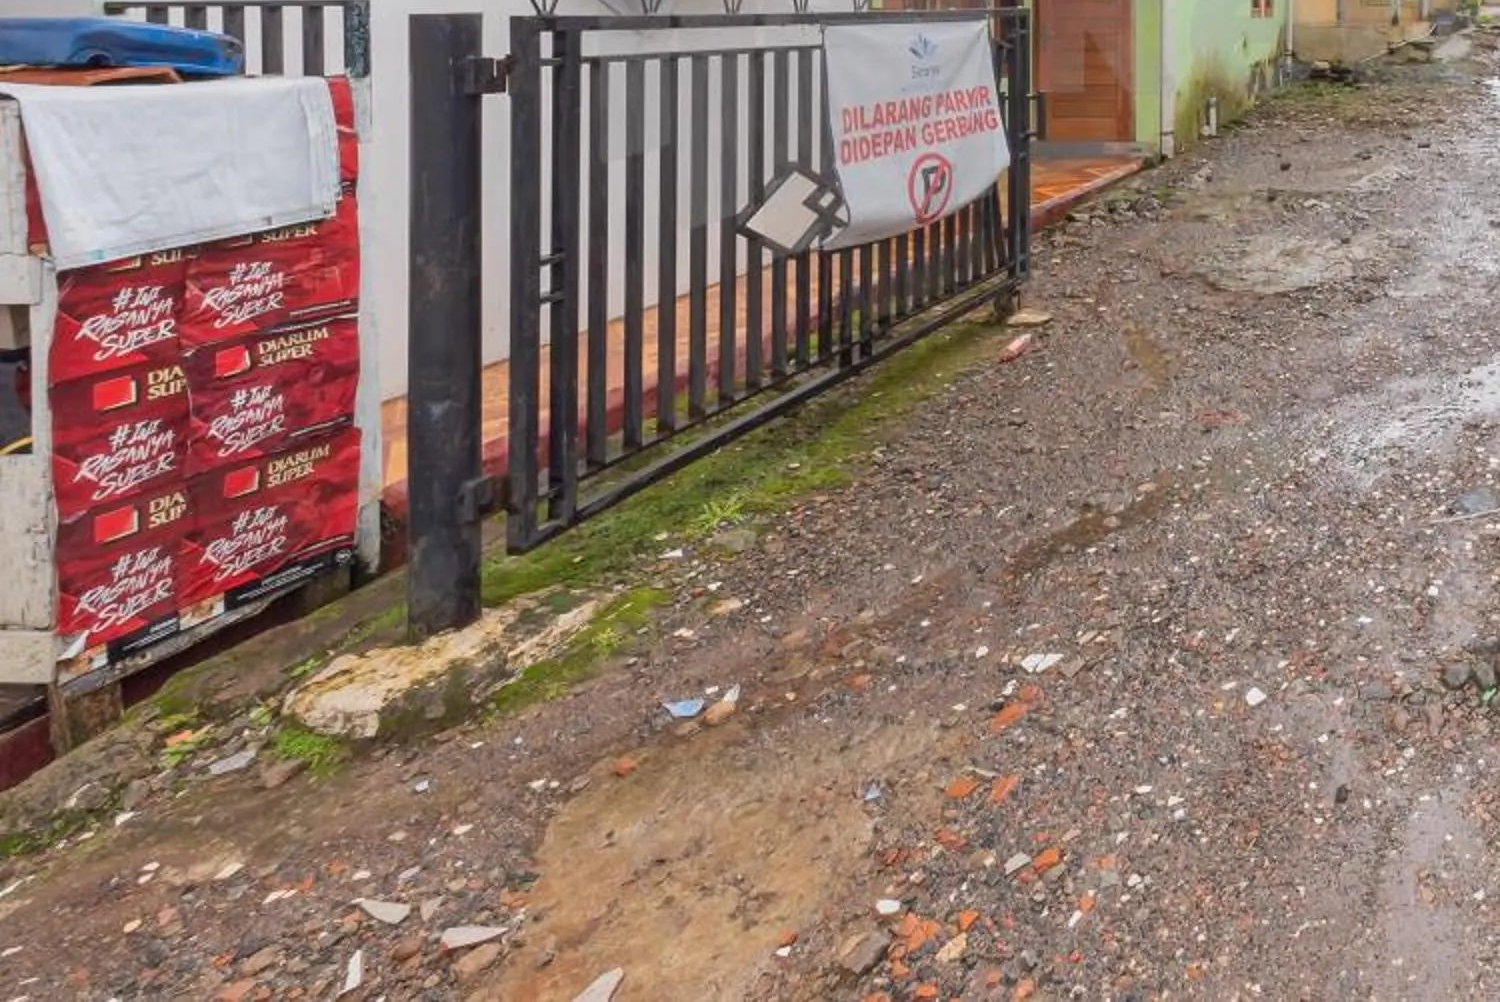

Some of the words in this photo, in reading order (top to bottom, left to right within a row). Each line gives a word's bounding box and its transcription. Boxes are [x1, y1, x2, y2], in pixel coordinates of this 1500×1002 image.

[841, 96, 932, 135] DILARANG
[840, 125, 917, 167] DIDEPAN
[213, 291, 286, 330] SUPER
[92, 318, 178, 361] SUPER
[147, 378, 188, 400] SUP
[217, 413, 288, 458] SUPER
[91, 450, 177, 501] SUPER
[148, 503, 188, 530] SUP
[213, 534, 288, 583] SUPER
[92, 577, 175, 633] SUPER
